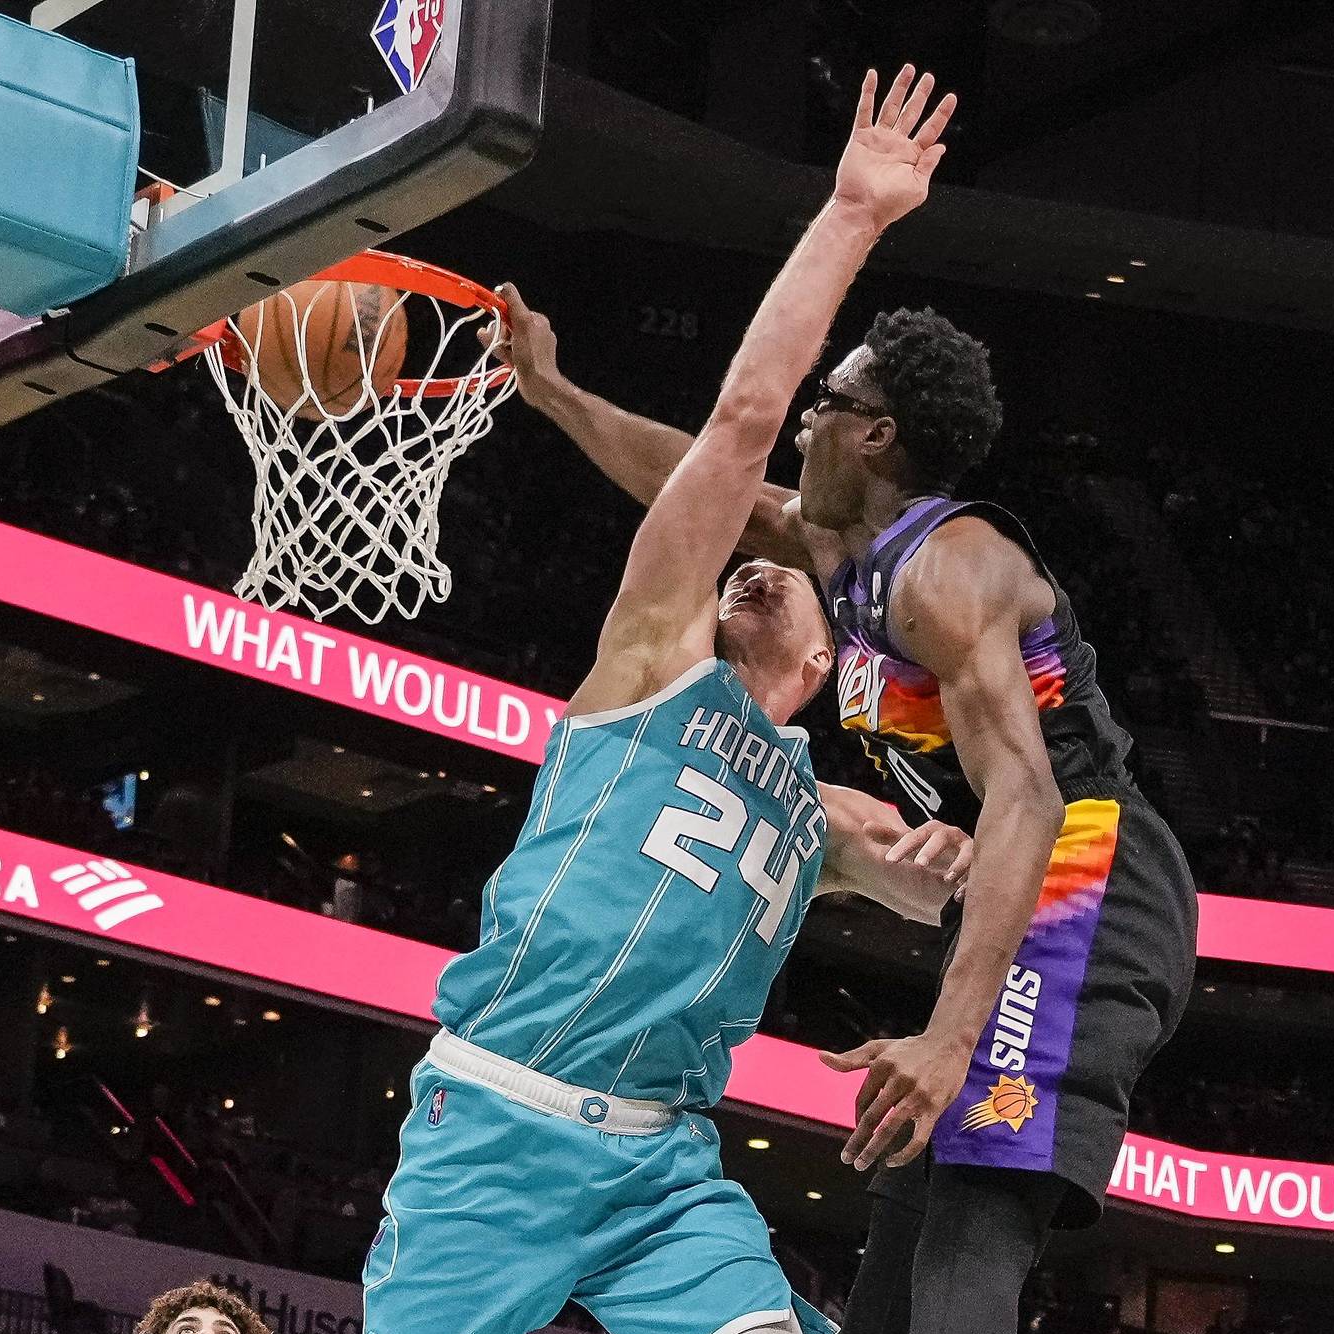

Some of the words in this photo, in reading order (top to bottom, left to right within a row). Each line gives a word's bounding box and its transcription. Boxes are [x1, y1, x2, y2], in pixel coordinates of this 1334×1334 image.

[184, 595, 336, 684] WHAT
[349, 647, 530, 745] WOULD
[639, 763, 800, 946] 24
[678, 705, 828, 862] HORNETS
